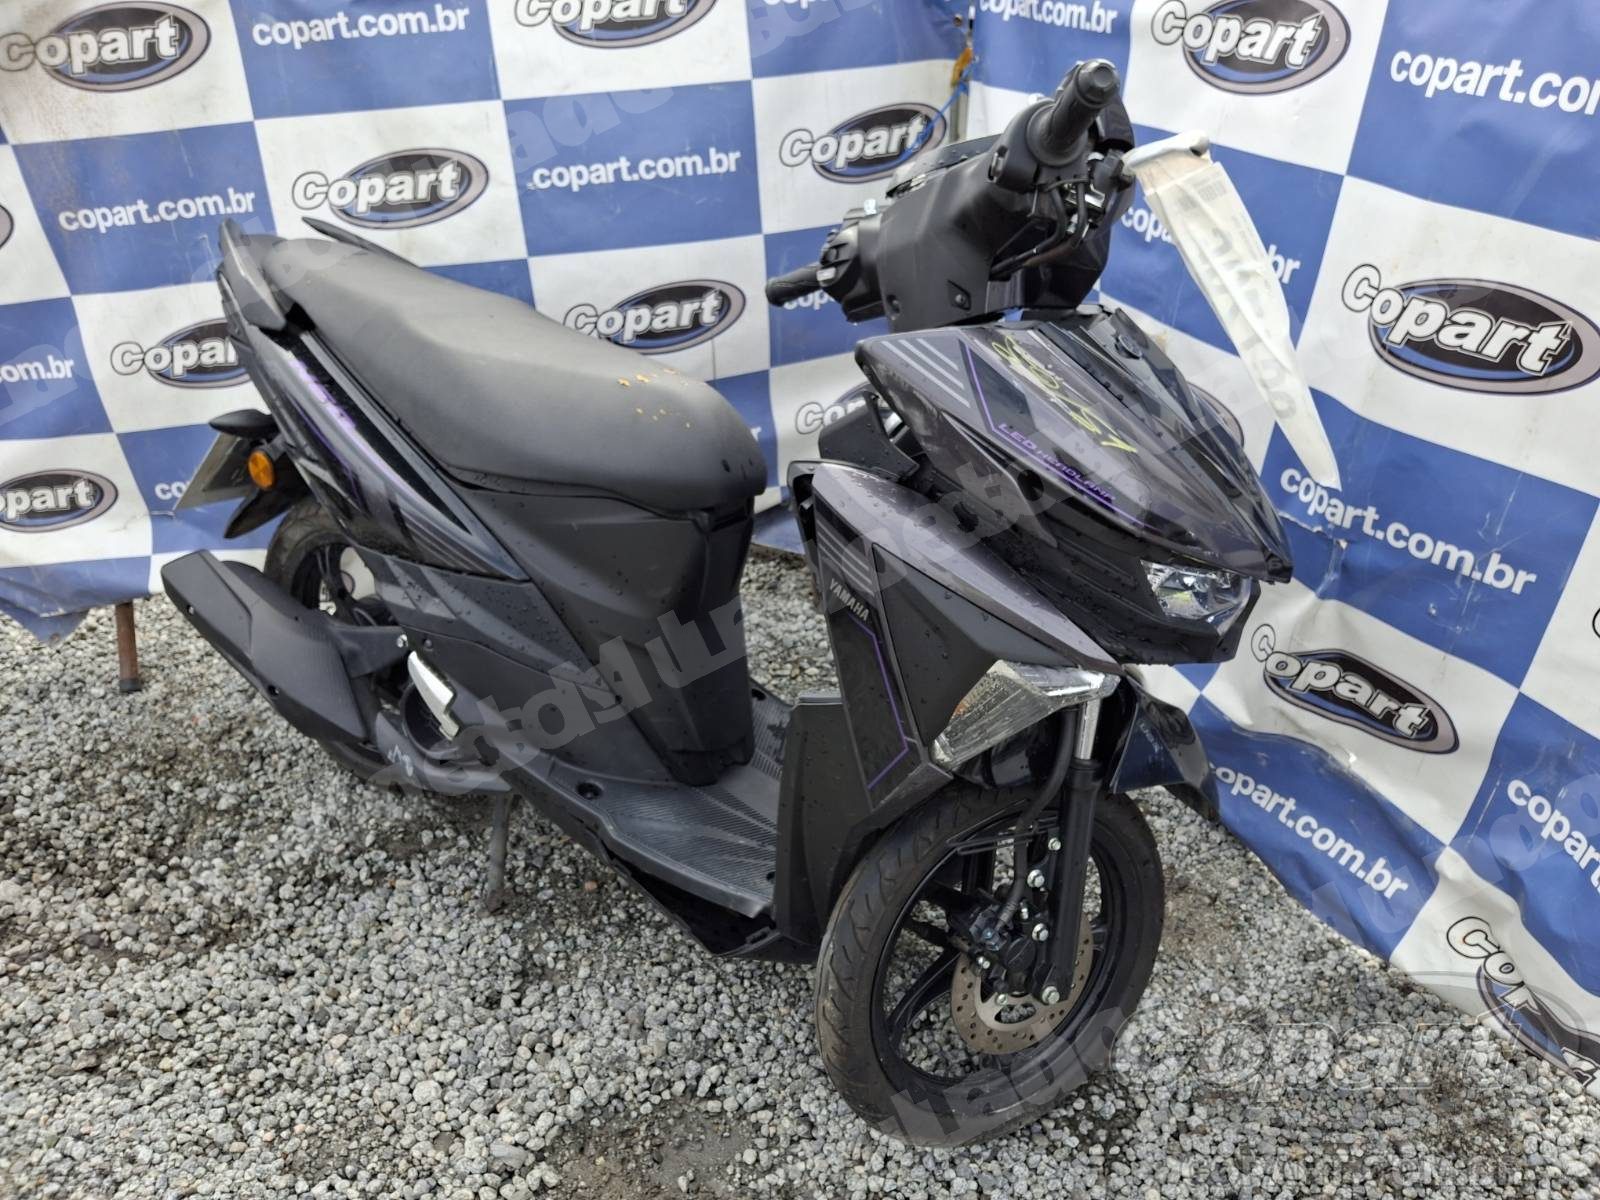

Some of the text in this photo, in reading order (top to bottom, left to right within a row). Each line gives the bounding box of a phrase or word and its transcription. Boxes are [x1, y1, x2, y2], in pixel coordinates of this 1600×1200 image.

[0, 14, 179, 76] Copart
[251, 4, 470, 48] copart.com.br
[1152, 0, 1325, 69] Copart
[532, 146, 741, 193] copart.com.br
[779, 113, 929, 171] Copart
[58, 188, 255, 234] copart.com.br
[292, 159, 463, 214] Copart
[562, 288, 725, 343] Copart
[1341, 263, 1573, 377] Copart
[998, 423, 1037, 450] LED
[0, 478, 96, 522] part
[1280, 467, 1536, 595] copart.com.br
[829, 578, 869, 621] YAMAHA
[1251, 623, 1430, 738] Copart
[1210, 762, 1409, 899] opart.com.br
